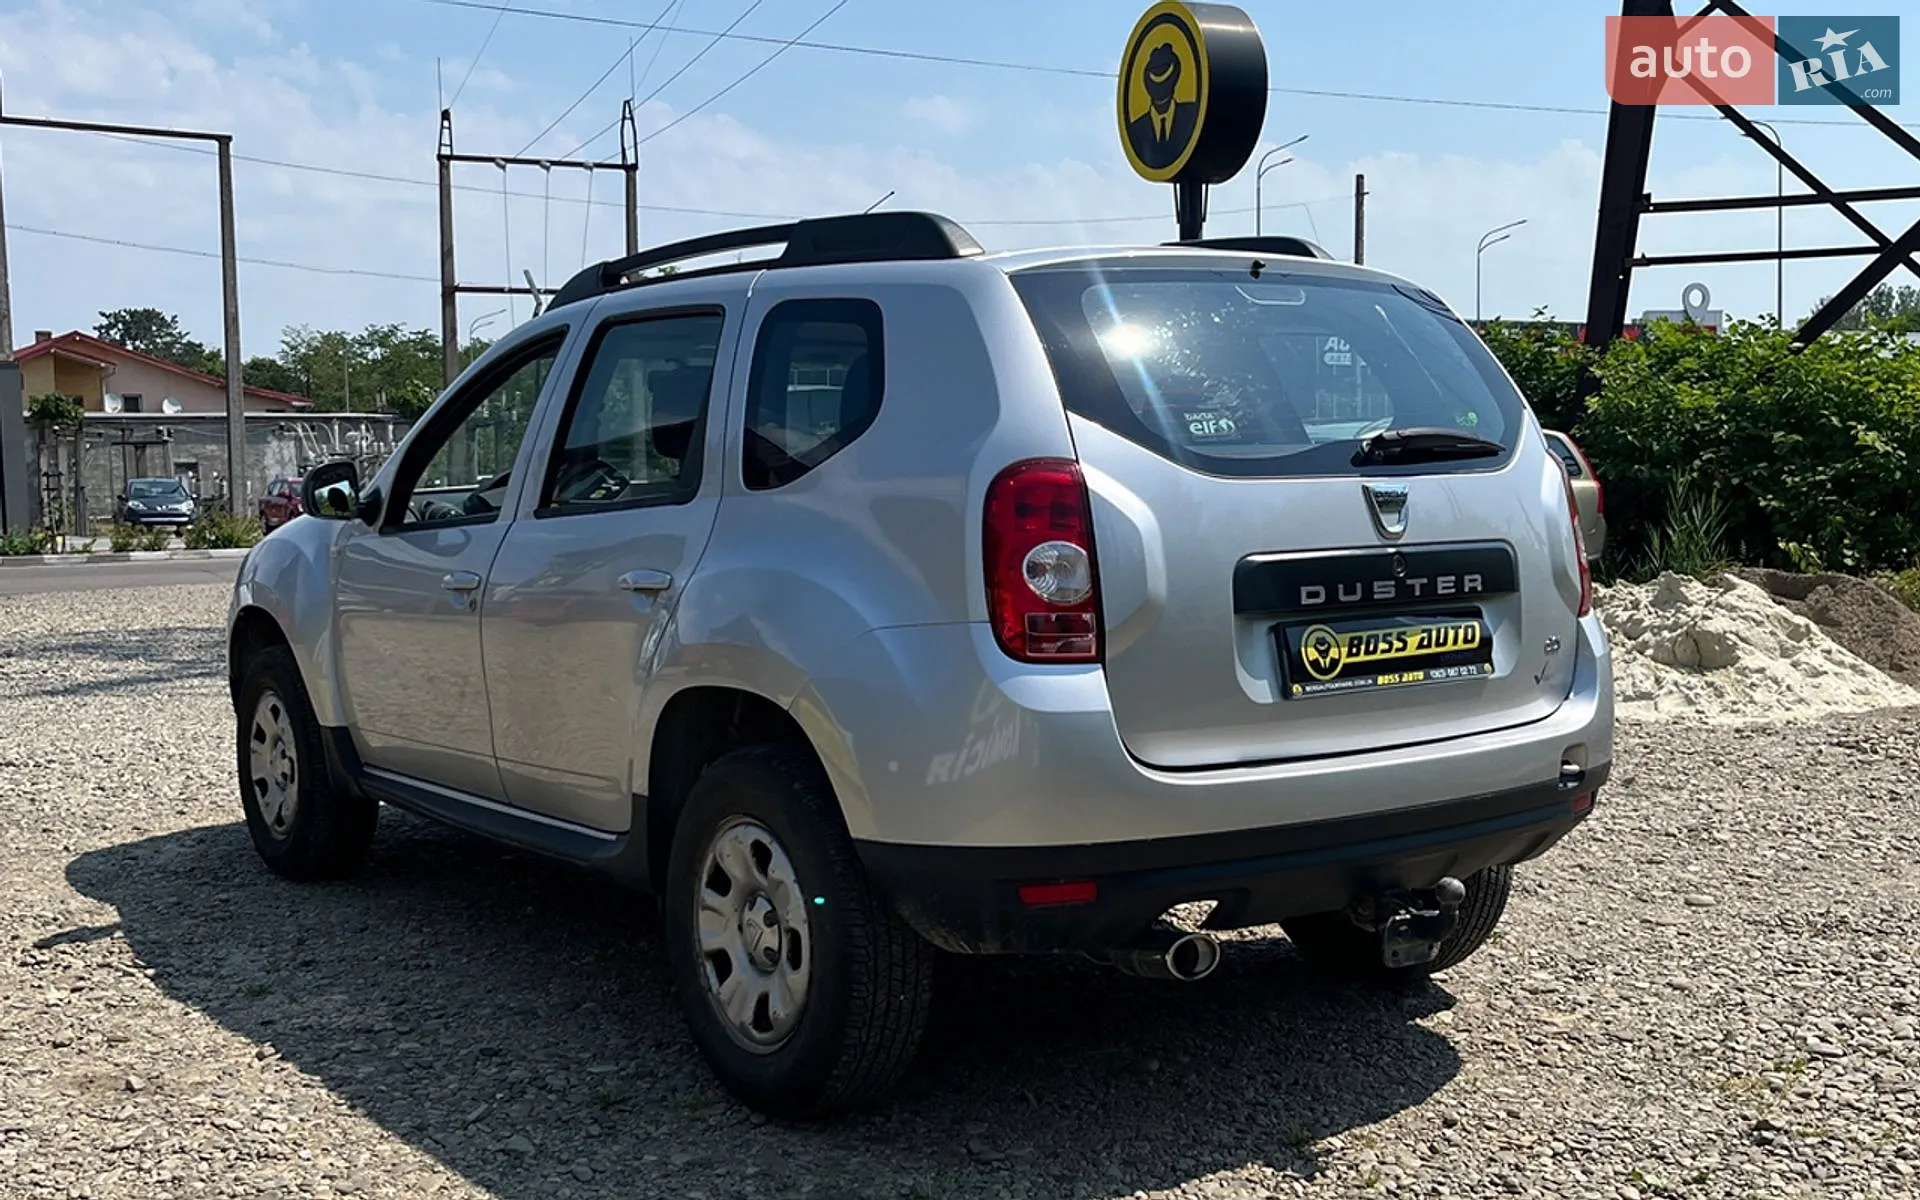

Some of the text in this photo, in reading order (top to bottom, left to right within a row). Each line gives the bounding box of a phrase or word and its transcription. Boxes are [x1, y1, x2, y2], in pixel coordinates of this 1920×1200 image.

[1189, 420, 1217, 435] elf
[1300, 573, 1483, 606] DUSTER
[1346, 623, 1477, 658] BOSS AUTO
